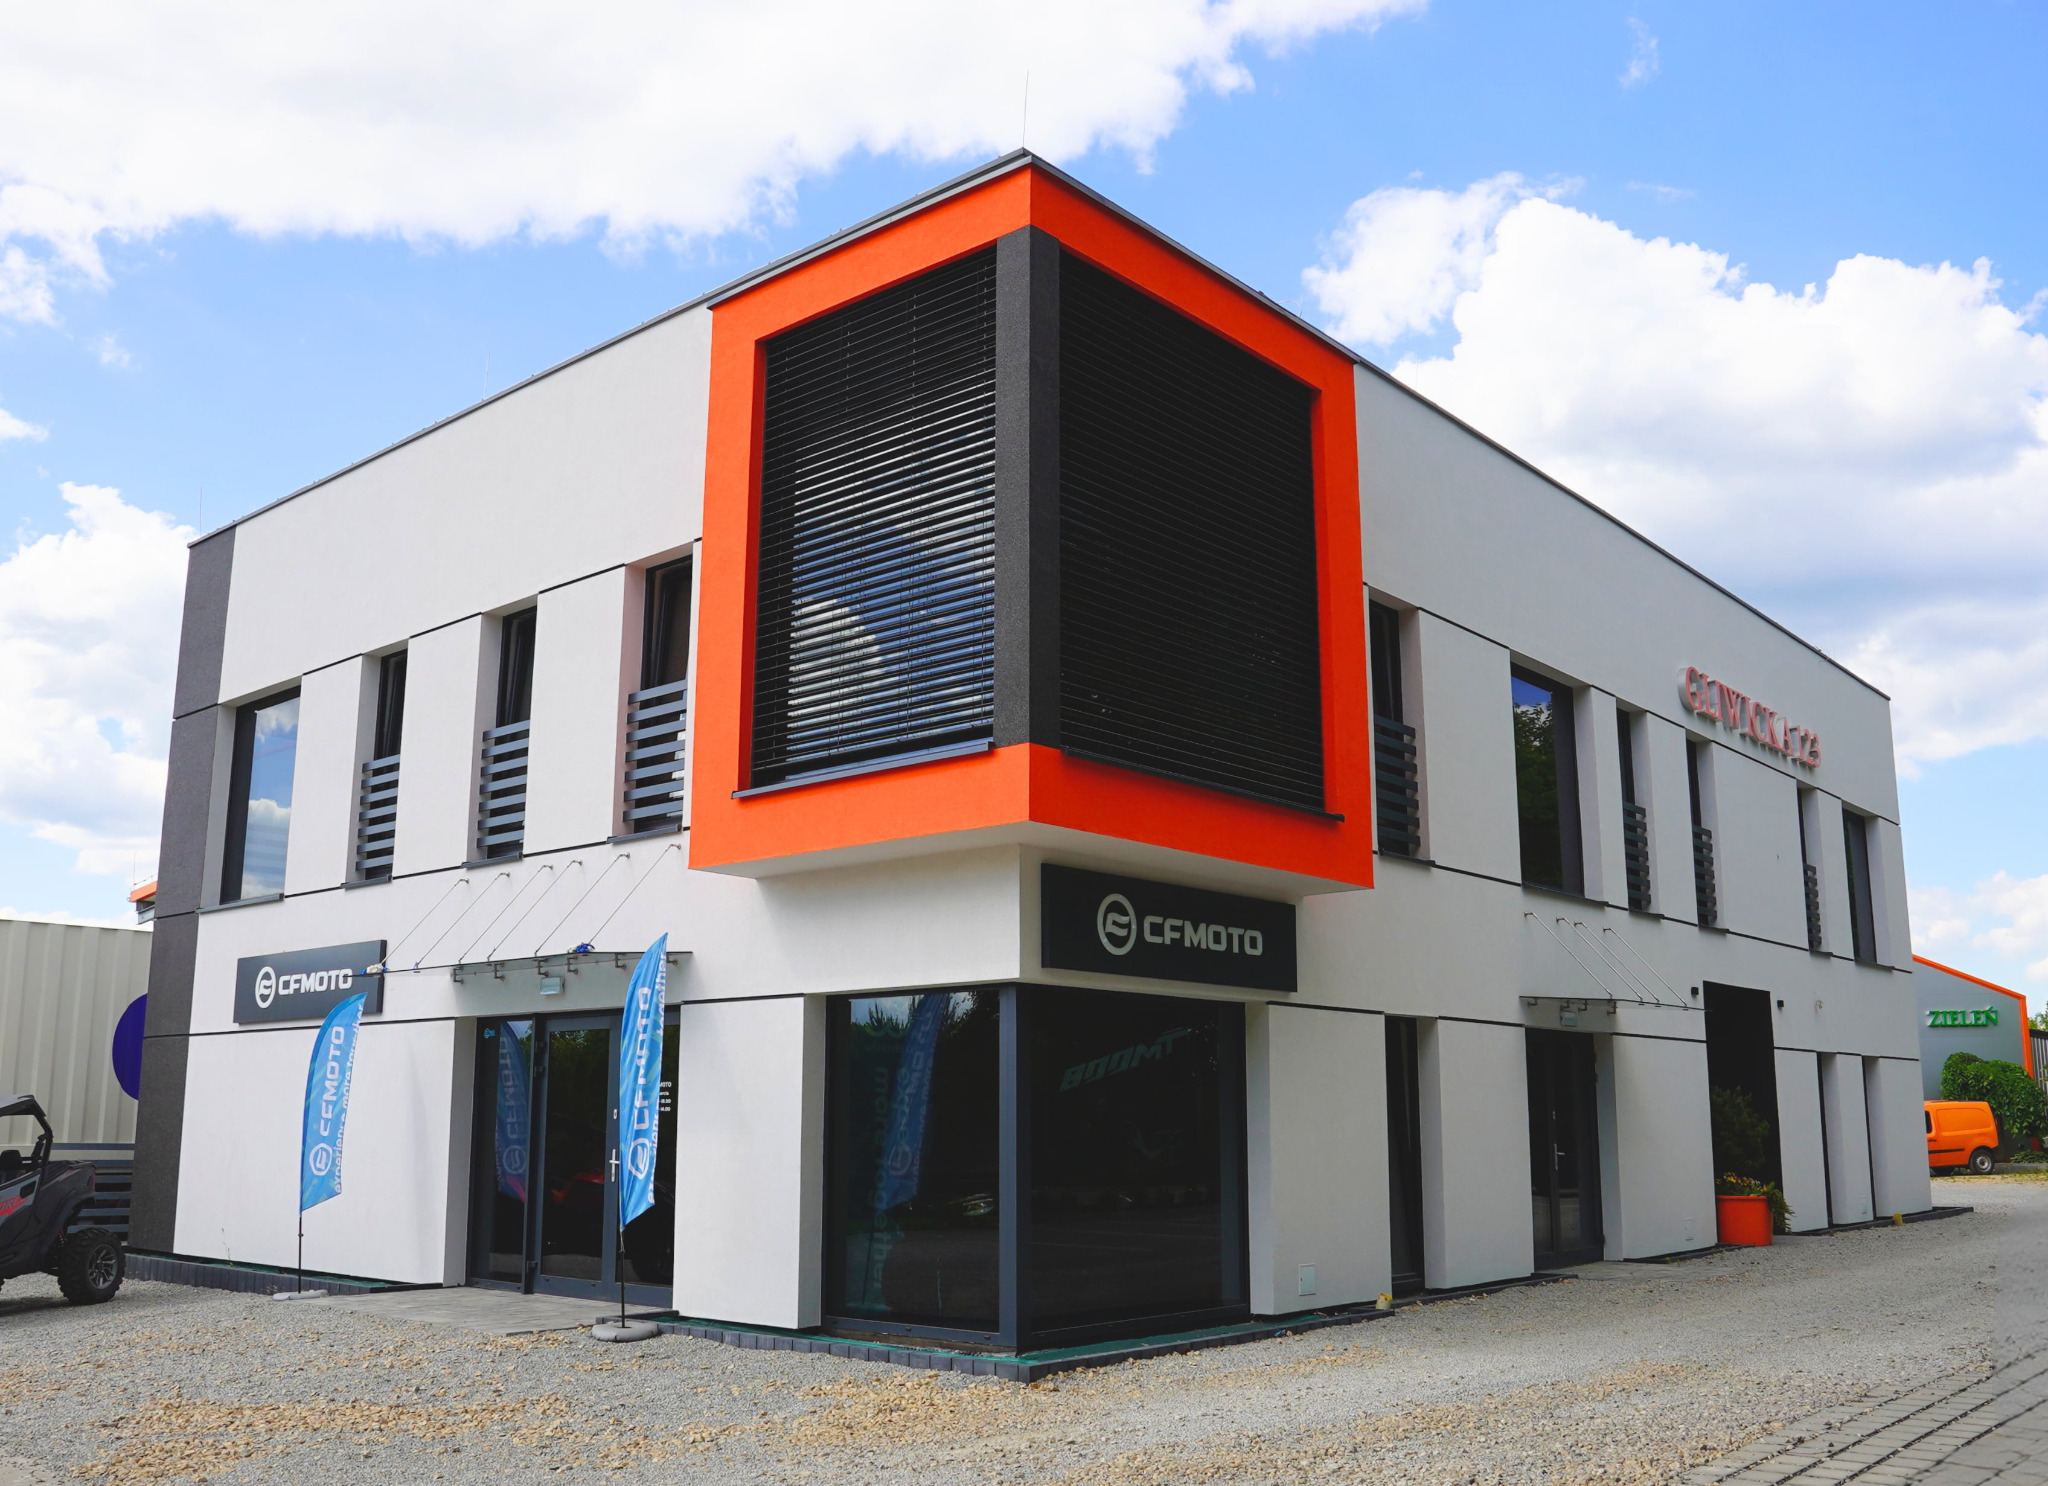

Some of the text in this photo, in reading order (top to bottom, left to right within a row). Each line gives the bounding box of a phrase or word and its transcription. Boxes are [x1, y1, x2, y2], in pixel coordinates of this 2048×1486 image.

[1678, 666, 1794, 757] GLIWICKA
[1143, 914, 1263, 956] CFMOTO
[278, 968, 353, 995] CFMOTO
[1928, 1006, 1998, 1027] ZIELEŃ
[319, 1026, 345, 1137] CFMOTO
